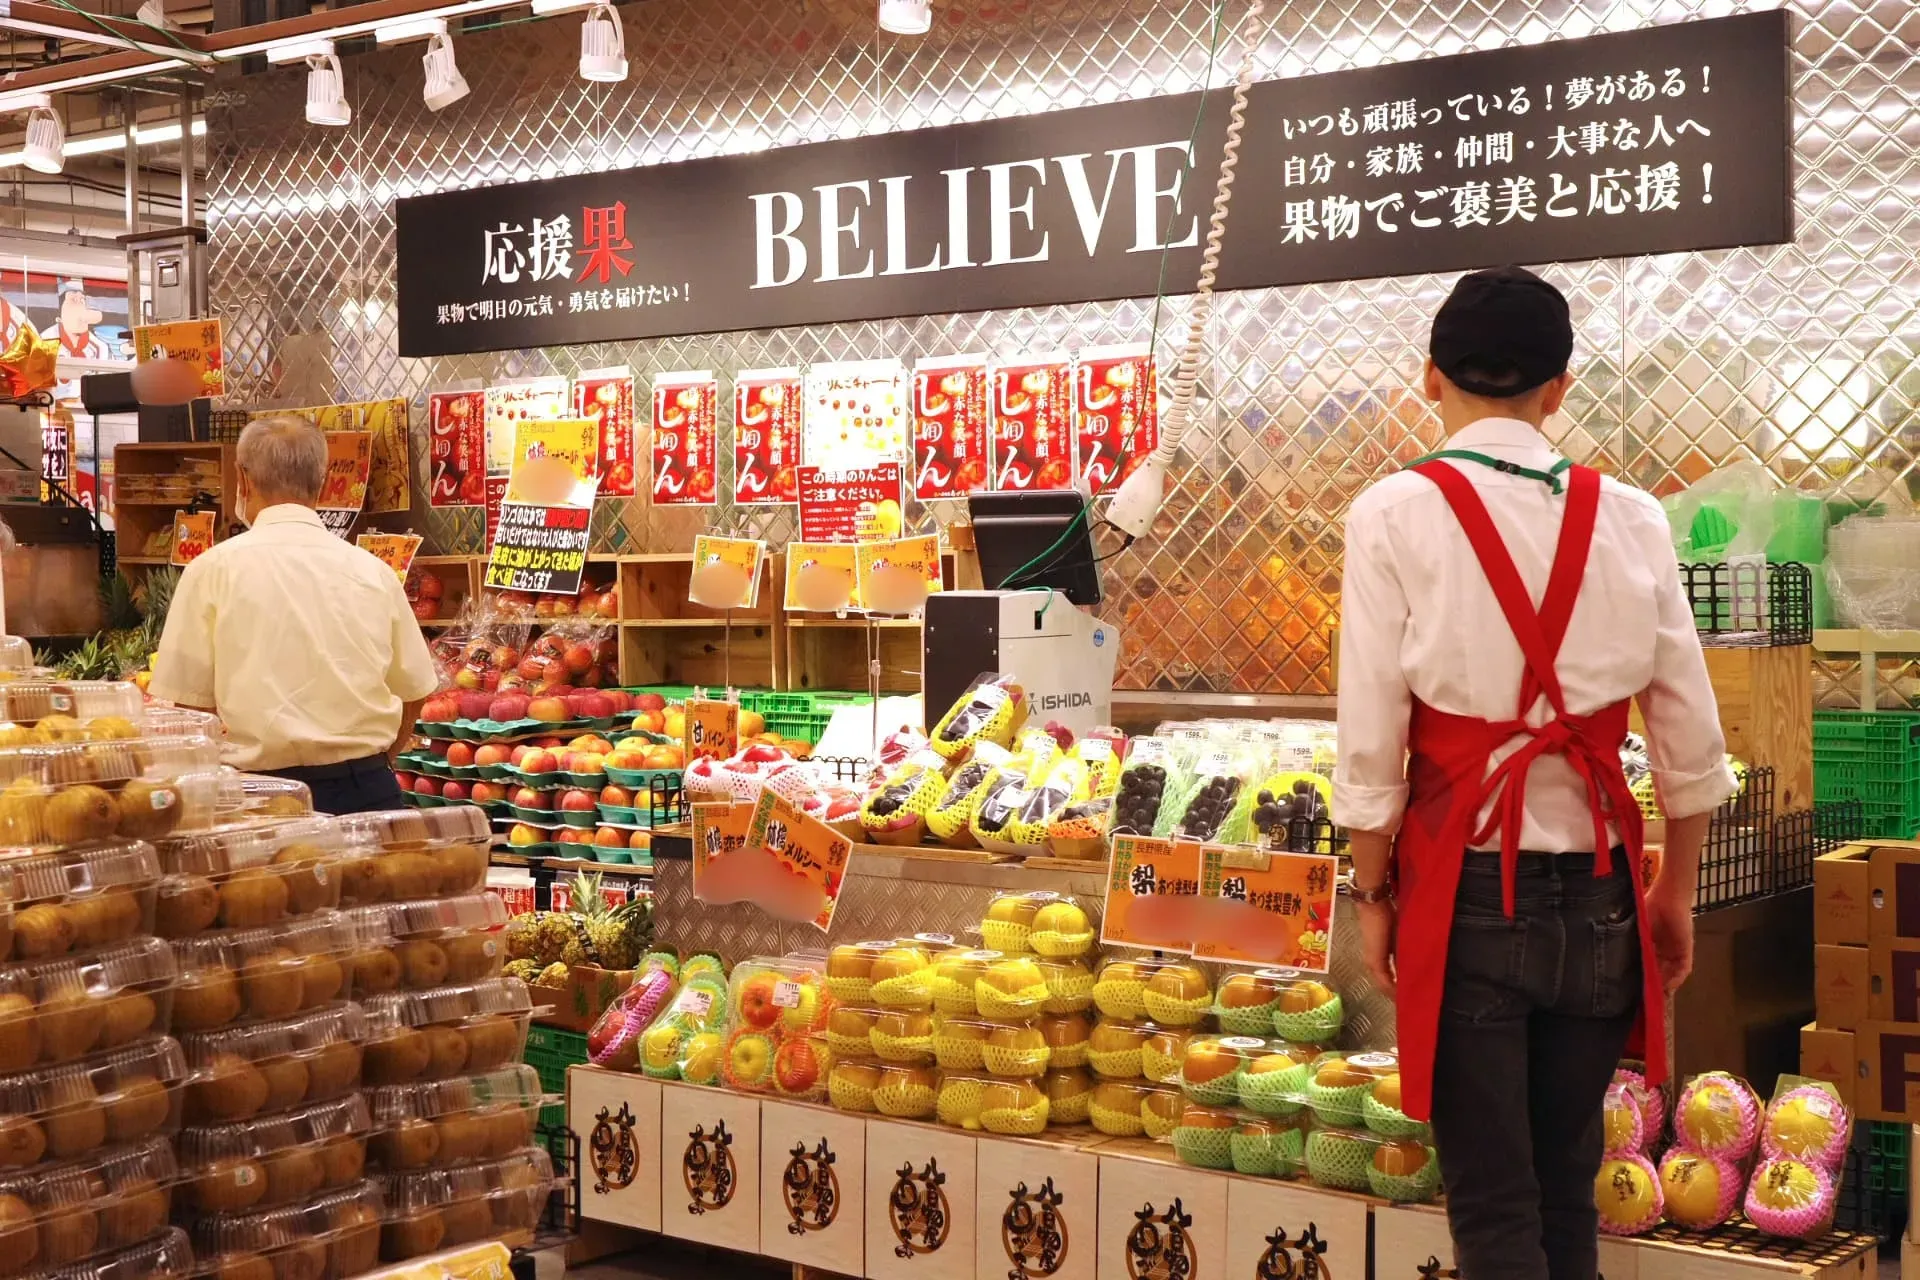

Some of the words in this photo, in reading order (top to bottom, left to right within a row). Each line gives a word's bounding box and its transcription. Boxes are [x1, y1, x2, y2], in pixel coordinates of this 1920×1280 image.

[1282, 66, 1712, 140] いつも頑張っている！夢がある！
[1283, 115, 1712, 187] 自分・家族・仲間・大事な人へ
[748, 140, 1199, 290] BELIEVE
[1281, 162, 1714, 245] 果物でご褒美と応援！
[436, 282, 691, 325] 果物で明日の元気・勇気を届けたい！
[1041, 691, 1092, 710] ISHIDA
[1132, 864, 1156, 895] 梨
